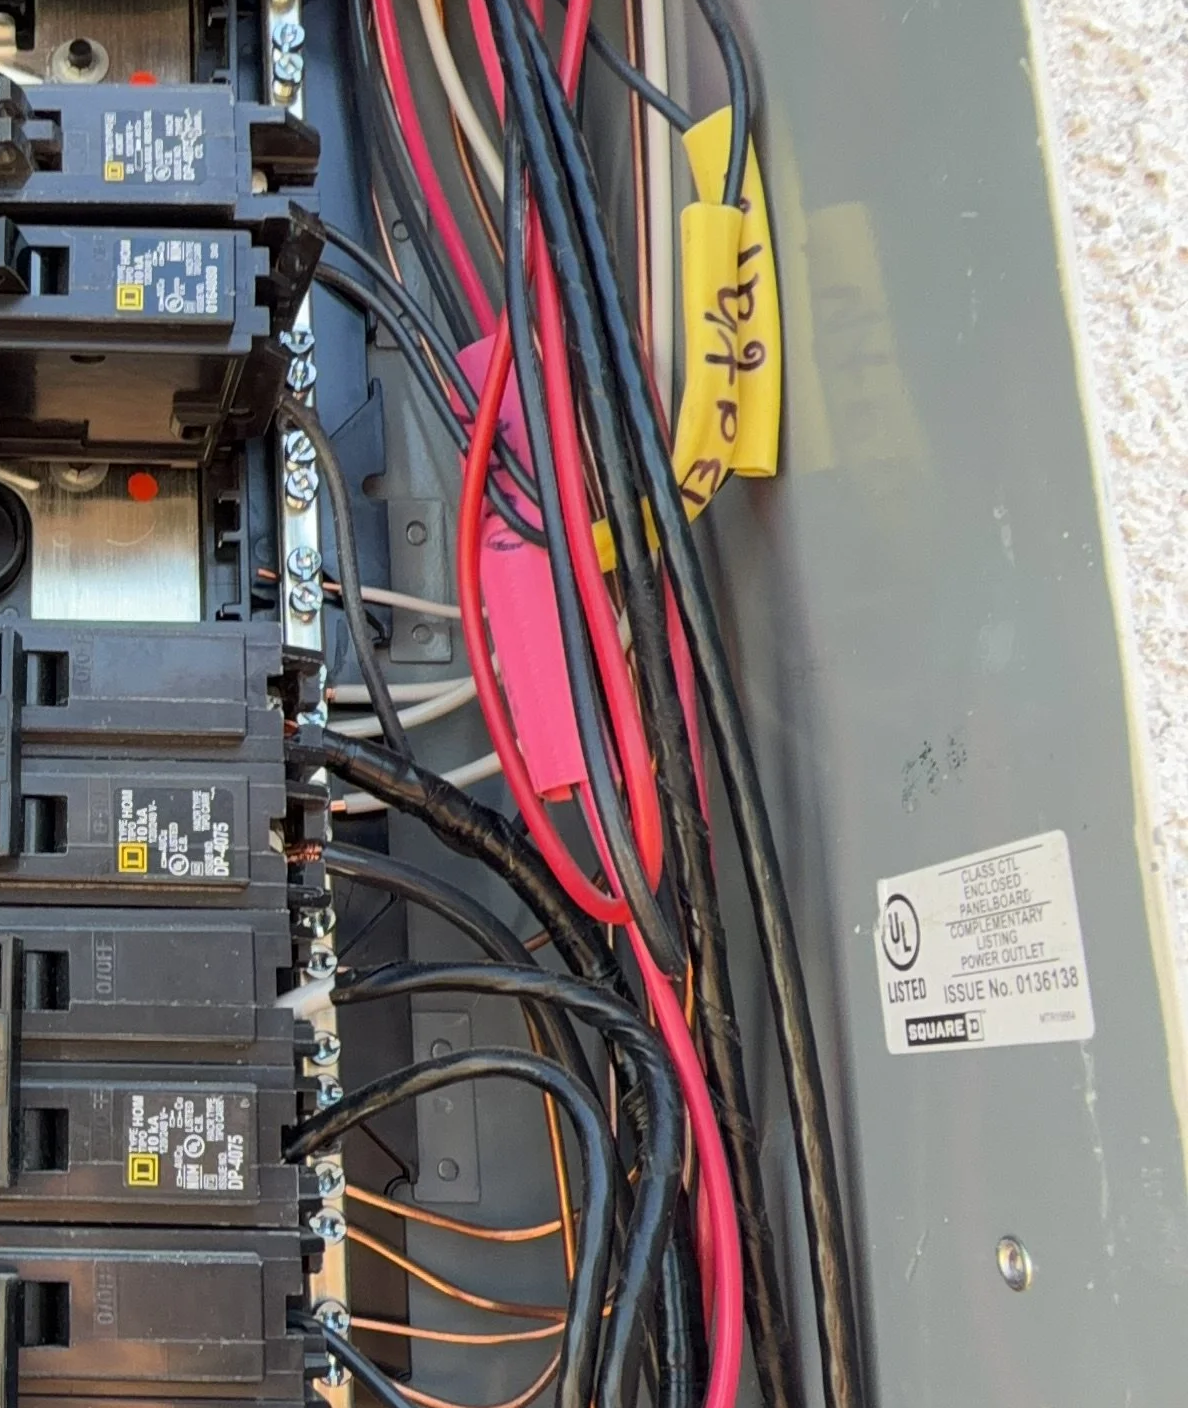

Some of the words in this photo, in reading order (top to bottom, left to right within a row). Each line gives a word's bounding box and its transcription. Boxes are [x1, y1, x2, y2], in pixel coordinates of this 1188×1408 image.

[122, 790, 133, 818] HOM
[137, 808, 147, 824] kA
[119, 820, 128, 841] TYPE
[138, 827, 147, 842] 10
[214, 823, 229, 876] DP-4075
[961, 864, 996, 884] CLASS
[997, 858, 1020, 876] CTL
[964, 874, 1021, 899] ENCLOSED
[960, 889, 1031, 917] PANELBOARD
[950, 908, 1043, 938] COMPLEMENTARY
[977, 930, 1018, 950] LISTING
[961, 951, 1000, 970] POWER
[1002, 943, 1045, 962] OUTLET
[888, 978, 927, 1004] LISTED
[944, 983, 985, 1004] ISSUE
[989, 977, 1012, 997] No.
[1016, 967, 1079, 994] 0136138
[908, 1018, 965, 1041] SQUARE
[133, 1095, 144, 1127] HOM
[148, 1116, 159, 1133] kA
[129, 1128, 138, 1152] TYPE
[148, 1136, 158, 1153] 10
[228, 1135, 243, 1190] DP-4075
